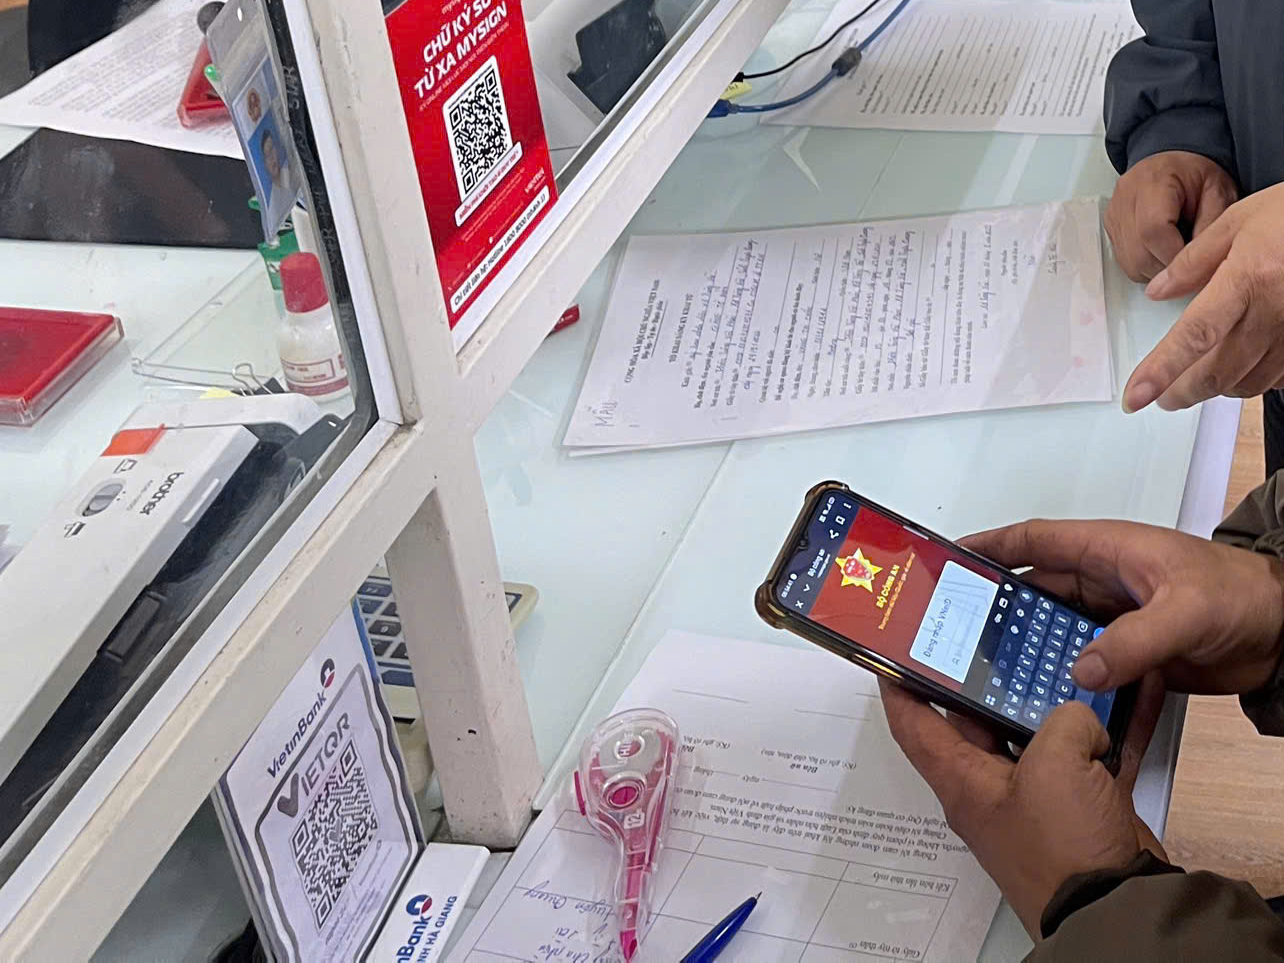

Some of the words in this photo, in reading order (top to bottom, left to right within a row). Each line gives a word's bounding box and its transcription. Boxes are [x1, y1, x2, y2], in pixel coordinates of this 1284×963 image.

[414, 66, 435, 98] TỪ
[435, 52, 456, 81] XA
[456, 0, 507, 61] MYSIGN
[423, 21, 452, 63] CHỮ
[452, 3, 471, 36] KÝ
[267, 690, 327, 778] VietinBank
